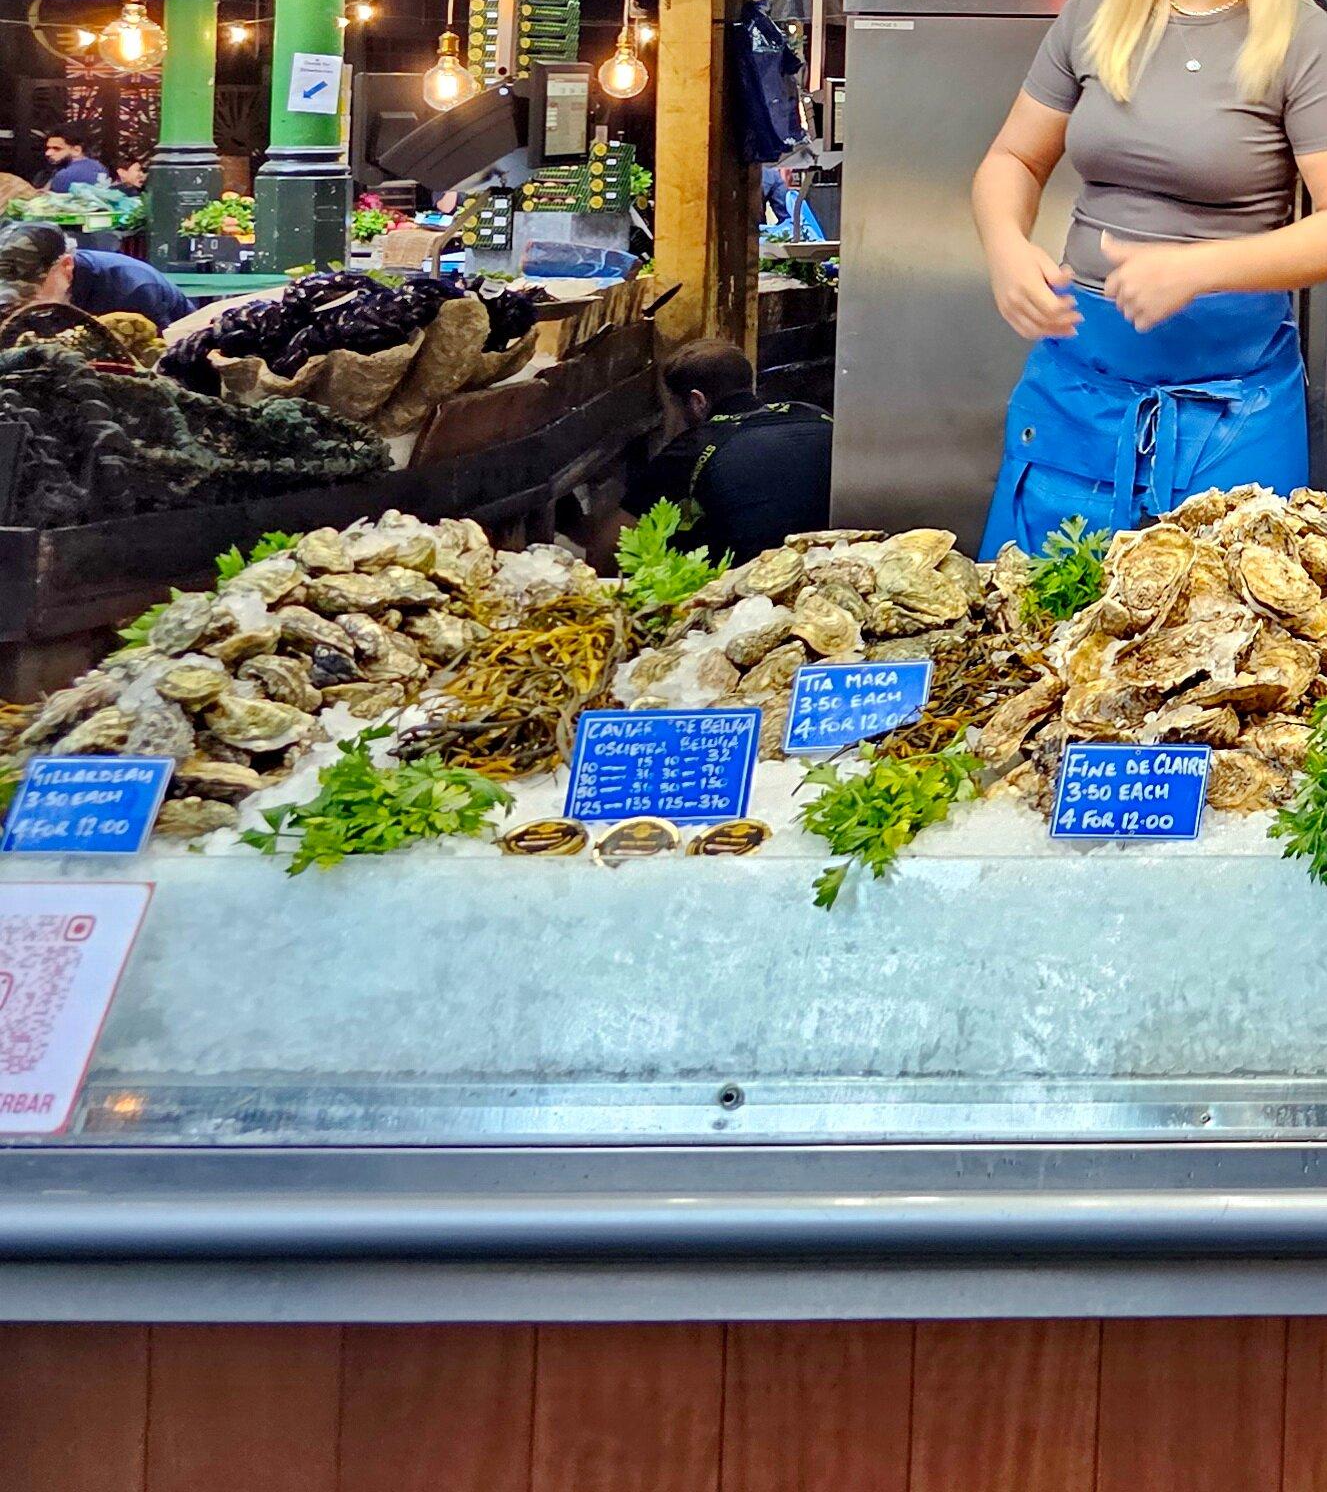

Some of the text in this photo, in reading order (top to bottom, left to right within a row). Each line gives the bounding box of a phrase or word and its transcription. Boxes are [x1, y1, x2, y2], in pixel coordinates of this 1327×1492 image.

[799, 671, 899, 692] TIA MARA
[850, 690, 902, 708] EACH
[793, 717, 816, 740] 4
[820, 716, 855, 735] FOR
[1067, 753, 1117, 779] FINE
[1125, 758, 1150, 776] DE
[1118, 781, 1170, 802] EACH
[574, 800, 602, 816] 125
[625, 797, 652, 811] 135
[657, 796, 684, 810] 125
[1058, 807, 1077, 830] 4
[1081, 808, 1115, 829] FOR
